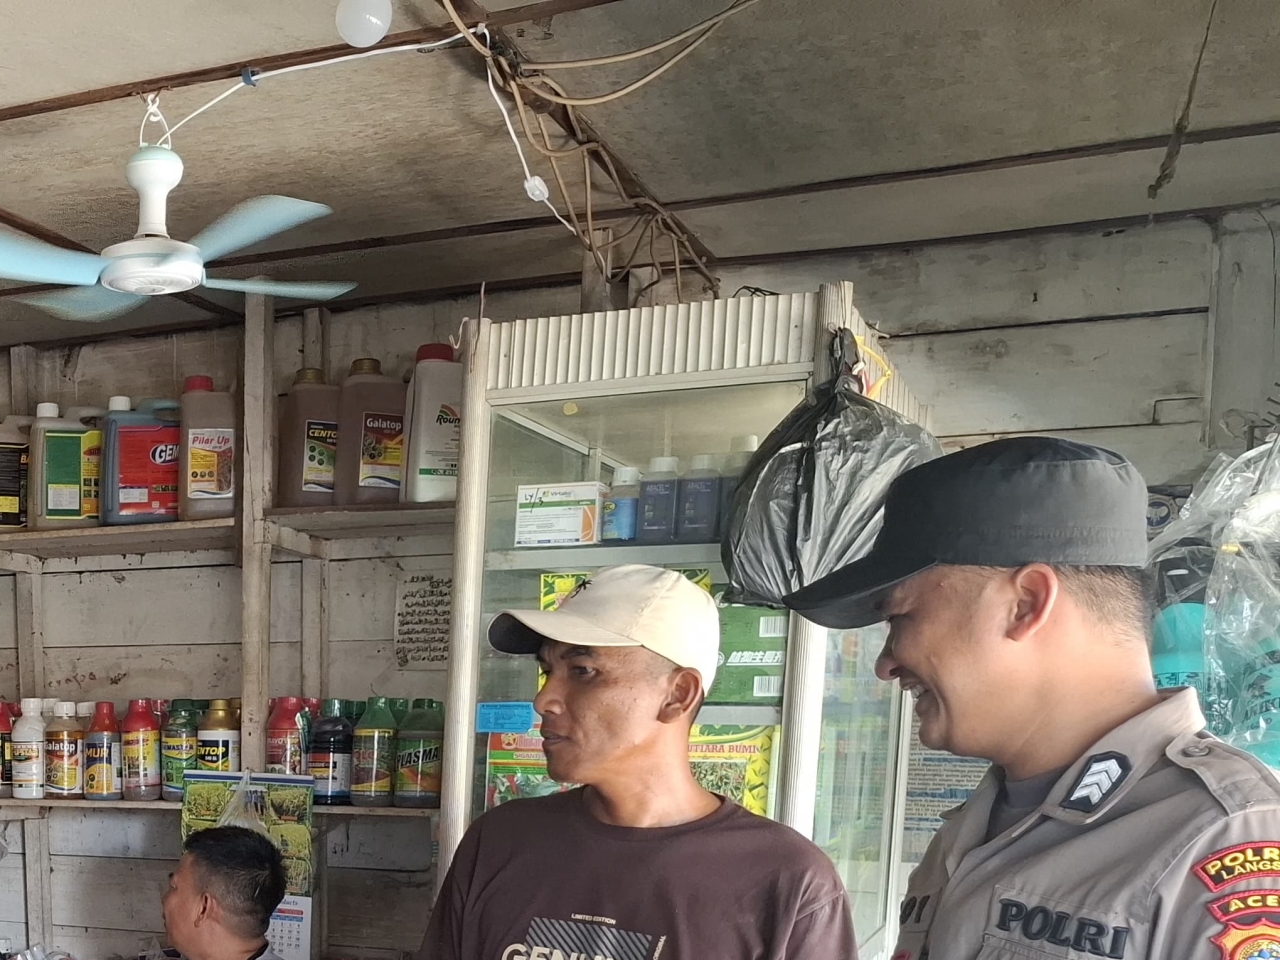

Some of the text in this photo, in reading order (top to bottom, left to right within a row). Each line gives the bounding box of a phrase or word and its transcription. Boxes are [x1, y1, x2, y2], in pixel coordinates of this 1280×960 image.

[366, 417, 402, 432] Galatop
[192, 435, 230, 446] Pilar Up
[727, 744, 757, 754] BUMI
[570, 912, 617, 925] LIMITED EDITION
[997, 898, 1130, 960] POLRI
[652, 934, 667, 960] ORIGINAL
